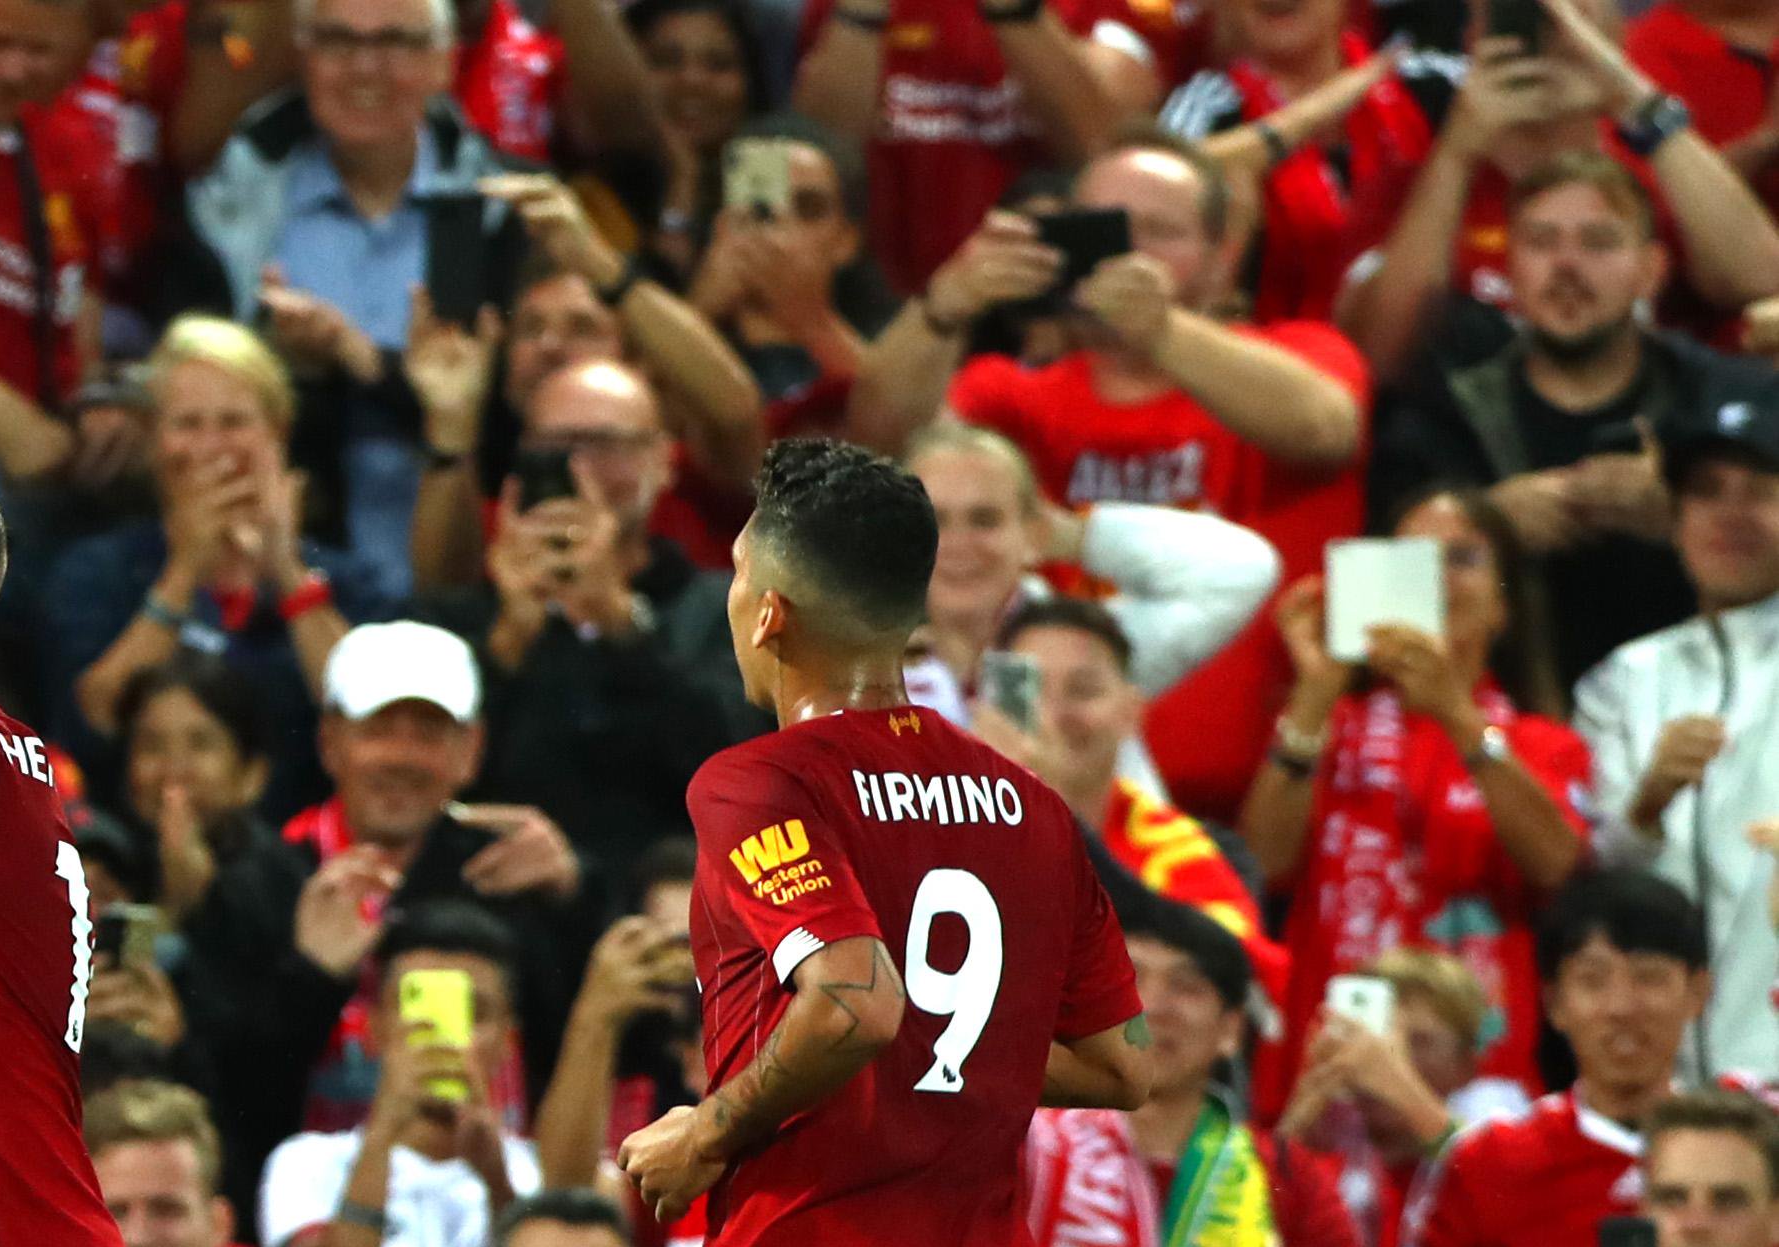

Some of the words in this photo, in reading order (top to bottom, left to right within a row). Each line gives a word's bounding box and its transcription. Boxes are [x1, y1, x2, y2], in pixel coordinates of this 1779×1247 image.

[851, 768, 1024, 827] FIRMINO
[728, 818, 811, 886] WU
[770, 875, 833, 906] Union
[904, 867, 1004, 1094] 9
